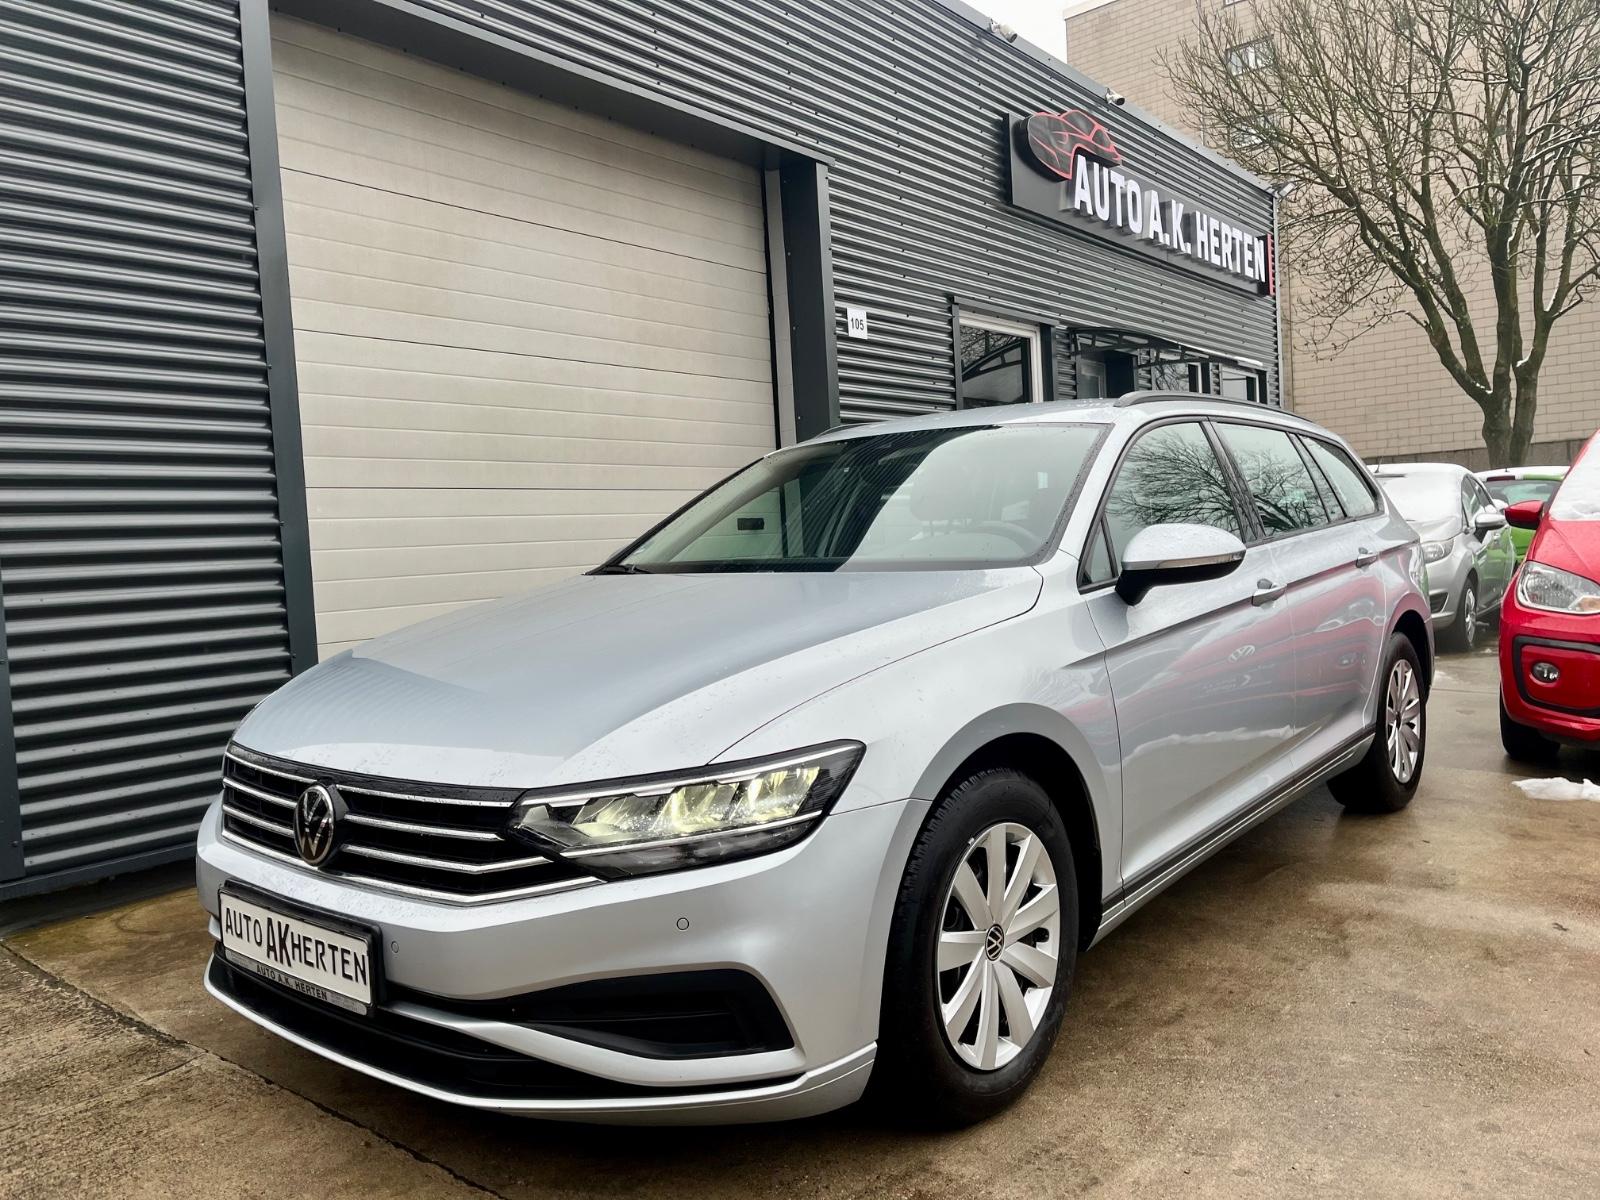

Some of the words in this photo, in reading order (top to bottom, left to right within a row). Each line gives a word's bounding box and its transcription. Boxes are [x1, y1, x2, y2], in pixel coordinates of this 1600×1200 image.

[1195, 211, 1266, 282] HERTEN
[850, 317, 865, 331] 105
[225, 907, 263, 947] AUTO
[256, 964, 276, 980] AUTO
[295, 982, 328, 1001] HERTEN
